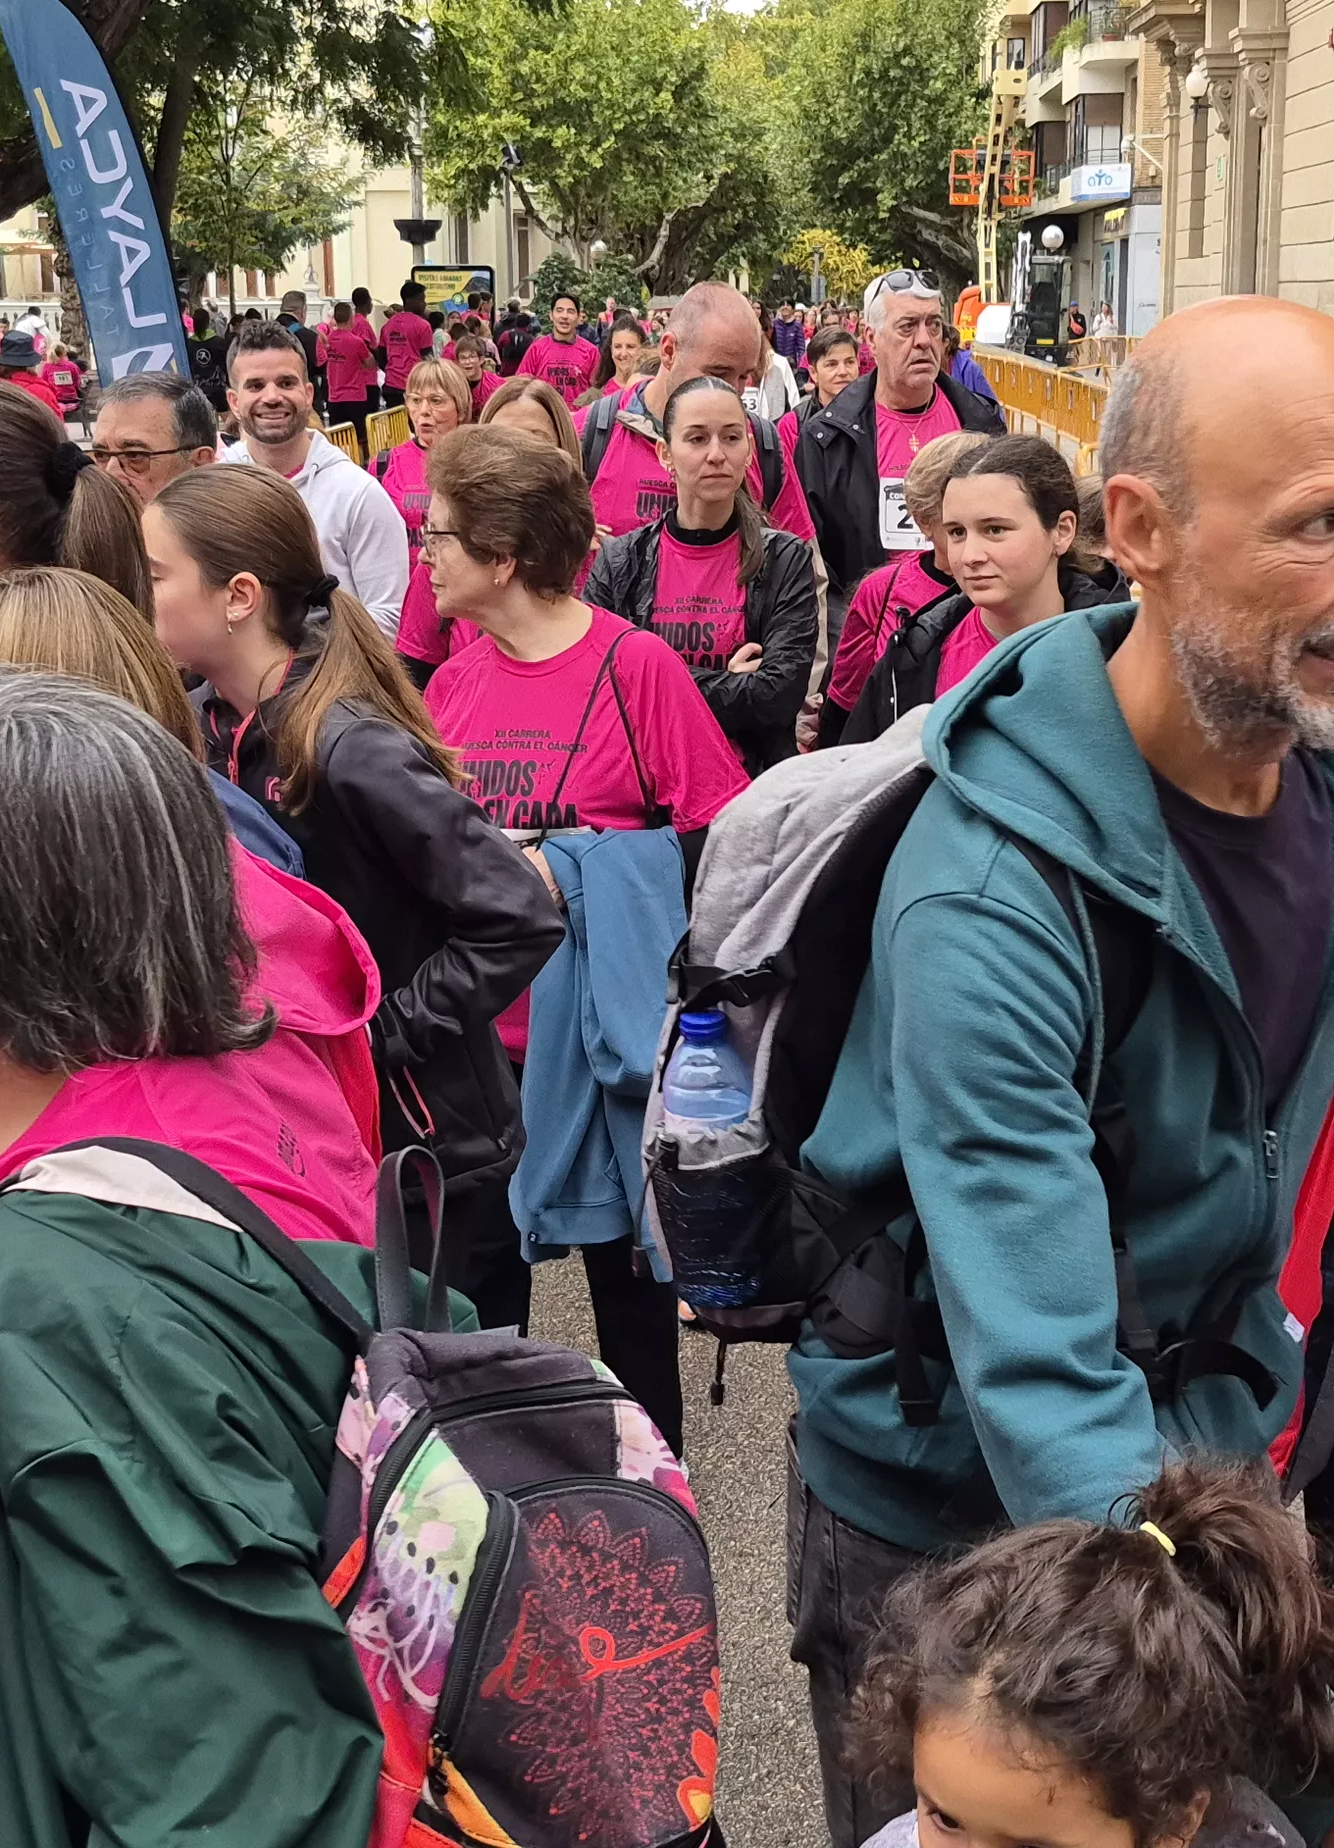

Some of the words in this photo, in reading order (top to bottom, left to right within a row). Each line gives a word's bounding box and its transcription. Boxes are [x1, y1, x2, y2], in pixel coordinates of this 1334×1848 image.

[686, 595, 724, 606] CARRERA
[676, 605, 708, 614] CONTRA
[495, 730, 507, 739] XII
[508, 729, 552, 740] CARRERA
[496, 741, 532, 750] CONTRA
[534, 742, 545, 750] EL
